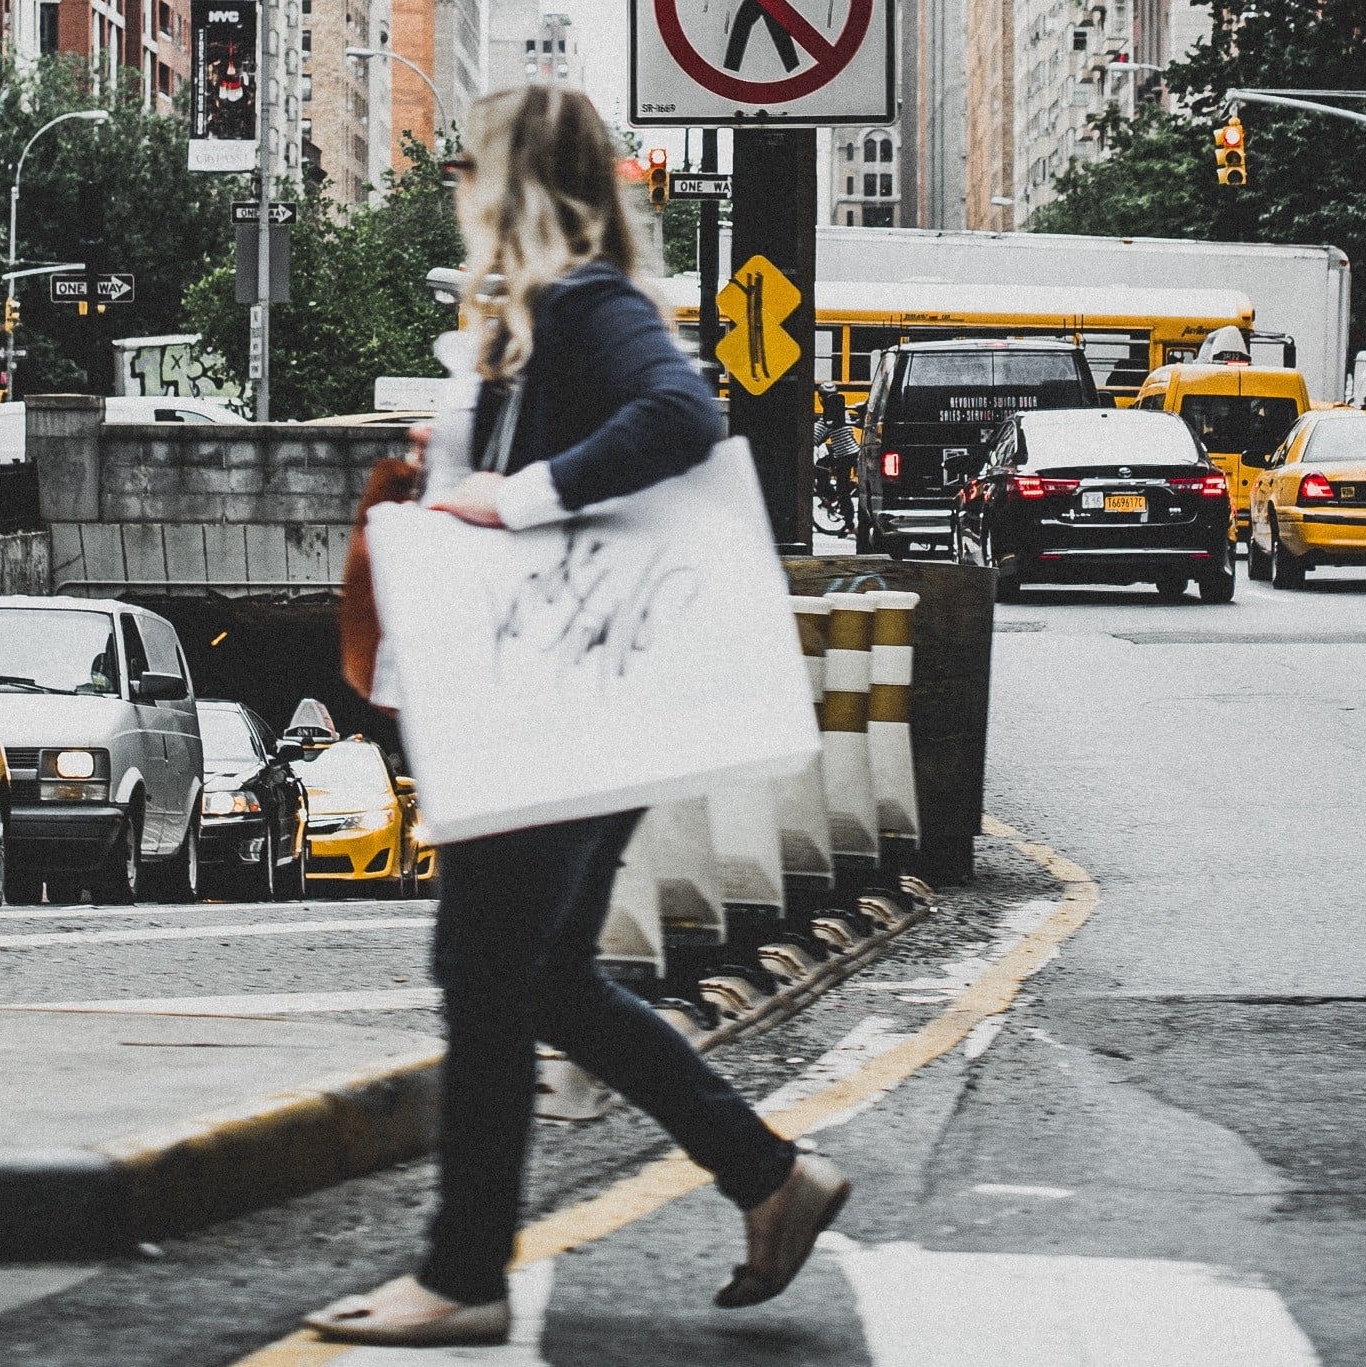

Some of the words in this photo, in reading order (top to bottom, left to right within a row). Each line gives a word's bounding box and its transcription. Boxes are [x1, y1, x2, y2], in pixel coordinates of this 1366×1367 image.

[208, 10, 240, 23] NYC
[680, 181, 703, 192] ONE
[713, 182, 730, 192] WA
[58, 283, 85, 294] ONE
[98, 283, 124, 294] WAY
[1107, 497, 1144, 509] T669617C
